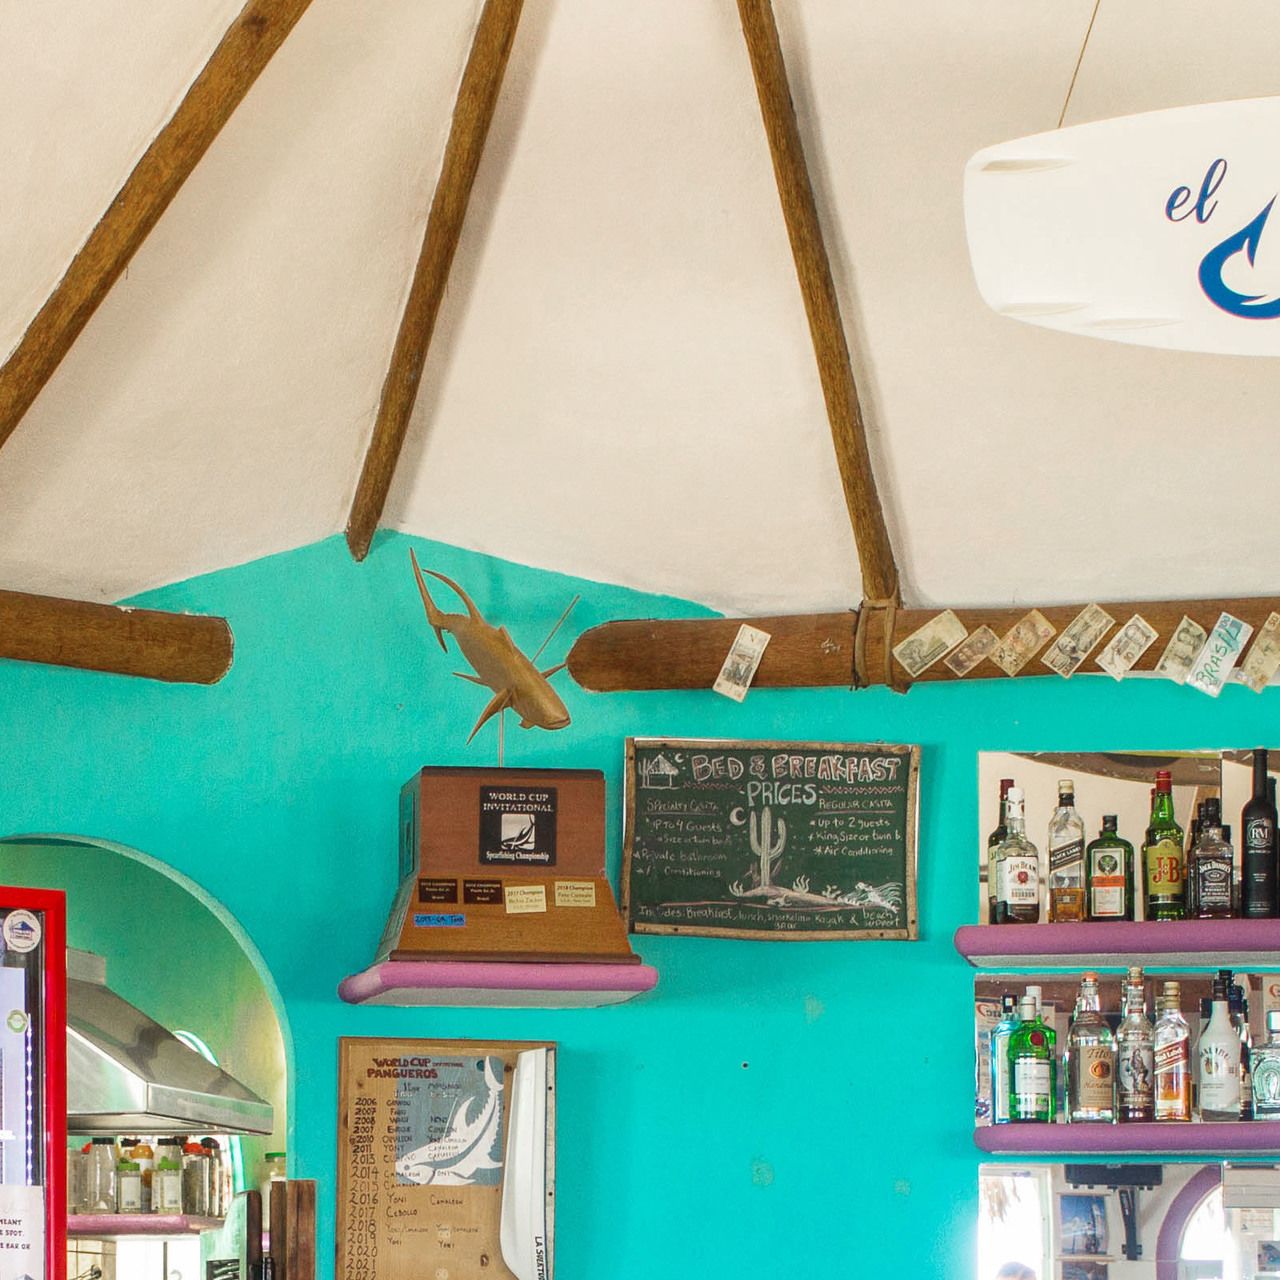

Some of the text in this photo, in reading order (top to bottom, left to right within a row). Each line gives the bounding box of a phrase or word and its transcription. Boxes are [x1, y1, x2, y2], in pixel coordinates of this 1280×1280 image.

[1165, 158, 1228, 224] el
[692, 754, 901, 783] BED & BREAKFAST
[489, 792, 549, 801] WORLD CUP
[483, 803, 554, 812] INVITATIONAL
[819, 799, 859, 810] REGULAR
[833, 818, 844, 827] to
[849, 817, 856, 827] 2
[858, 819, 890, 829] guests
[824, 846, 839, 856] Air
[372, 1058, 409, 1067] WORLD
[410, 1057, 431, 1067] CUP
[367, 1068, 438, 1079] PANGUEROS
[355, 1098, 377, 1106] 2006
[355, 1108, 377, 1116] 2007
[352, 1145, 372, 1154] 2011
[352, 1166, 379, 1179] 2014
[350, 1181, 379, 1192] 2015
[350, 1192, 378, 1205] 2016
[350, 1206, 375, 1218] 2017
[348, 1220, 376, 1232] 2018
[349, 1231, 376, 1244] 2019
[534, 1236, 543, 1247] LA
[347, 1246, 377, 1257] 2020
[346, 1259, 376, 1270] 2021
